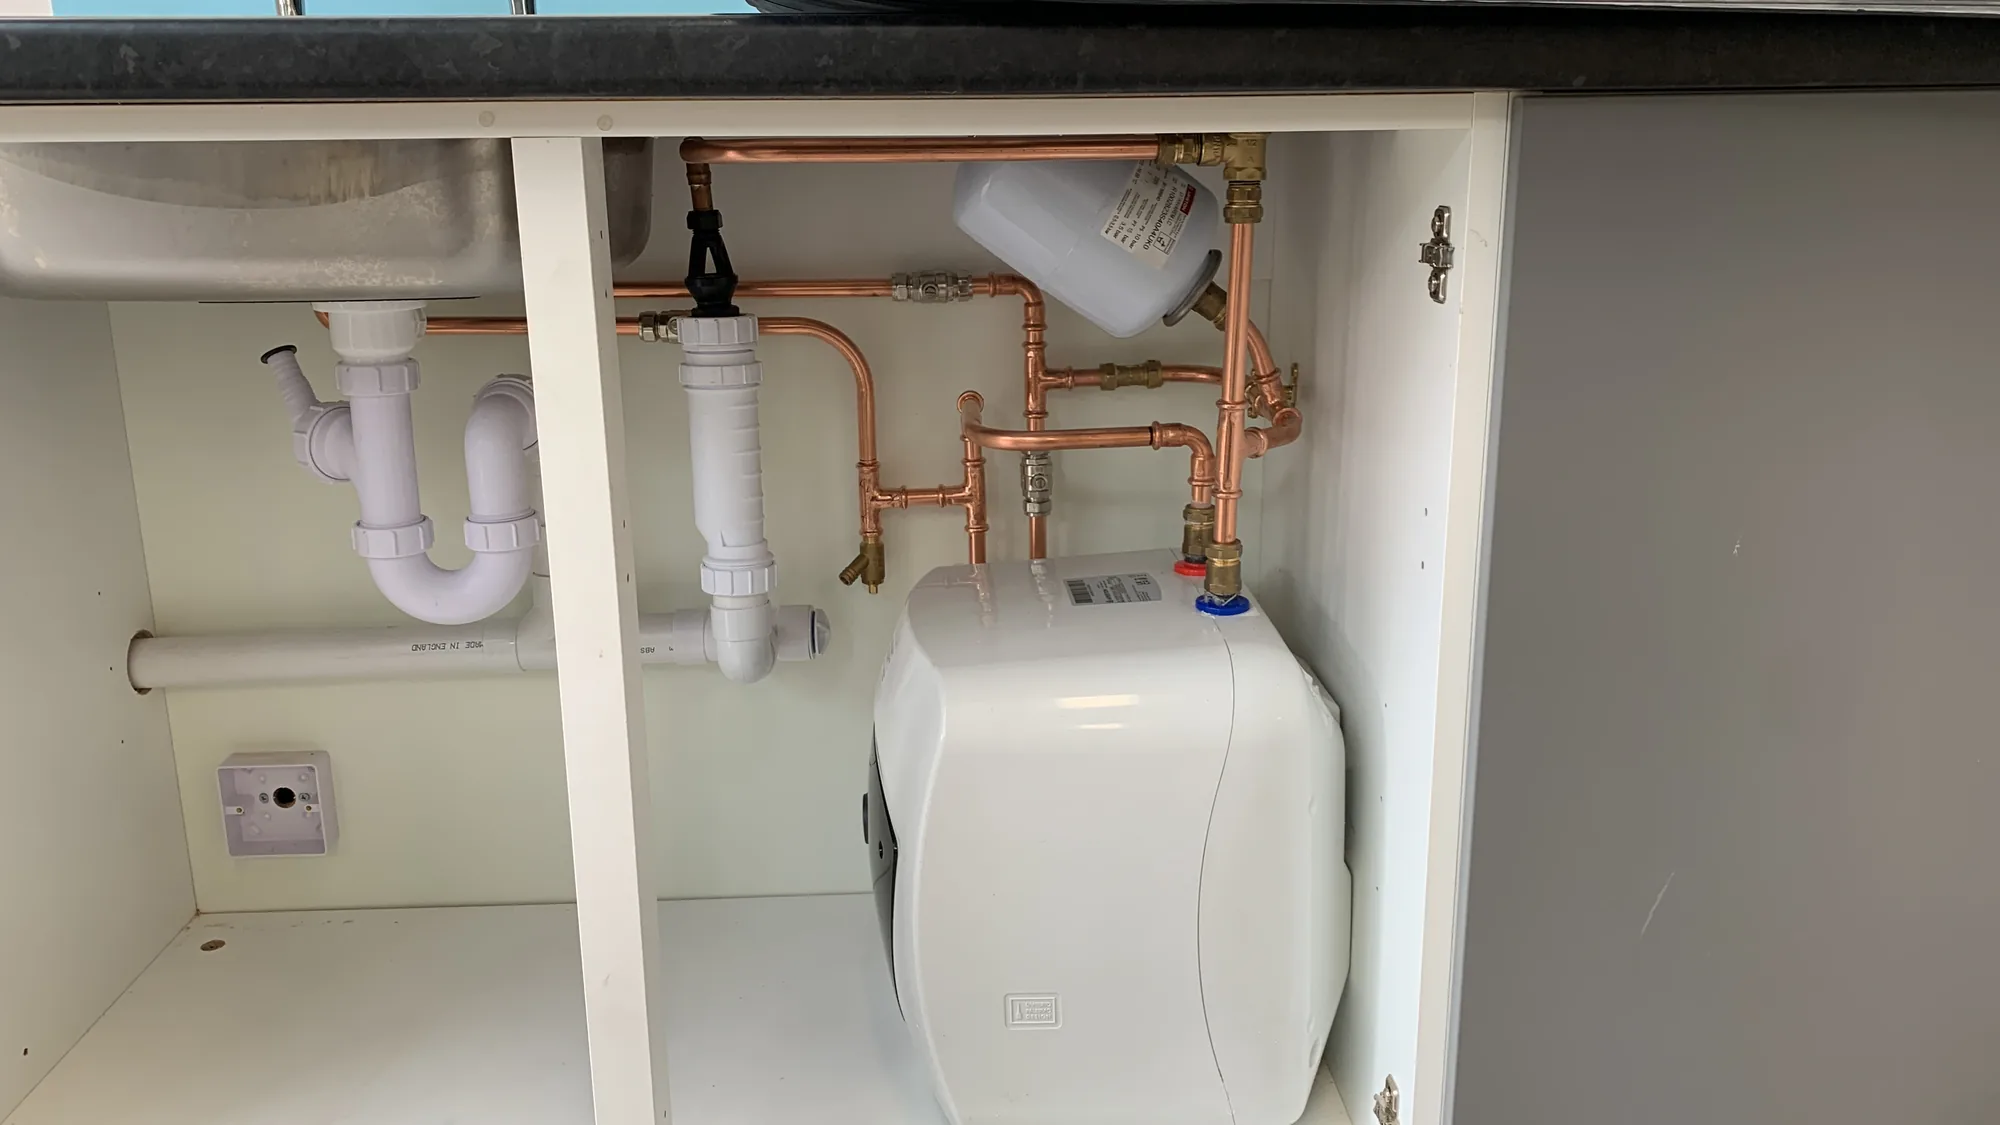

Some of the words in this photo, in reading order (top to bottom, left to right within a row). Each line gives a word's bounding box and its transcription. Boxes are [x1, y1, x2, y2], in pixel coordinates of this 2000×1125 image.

[1113, 229, 1121, 239] bar
[1120, 234, 1128, 244] bar
[1128, 239, 1137, 249] bar
[412, 643, 446, 651] ENGLAND
